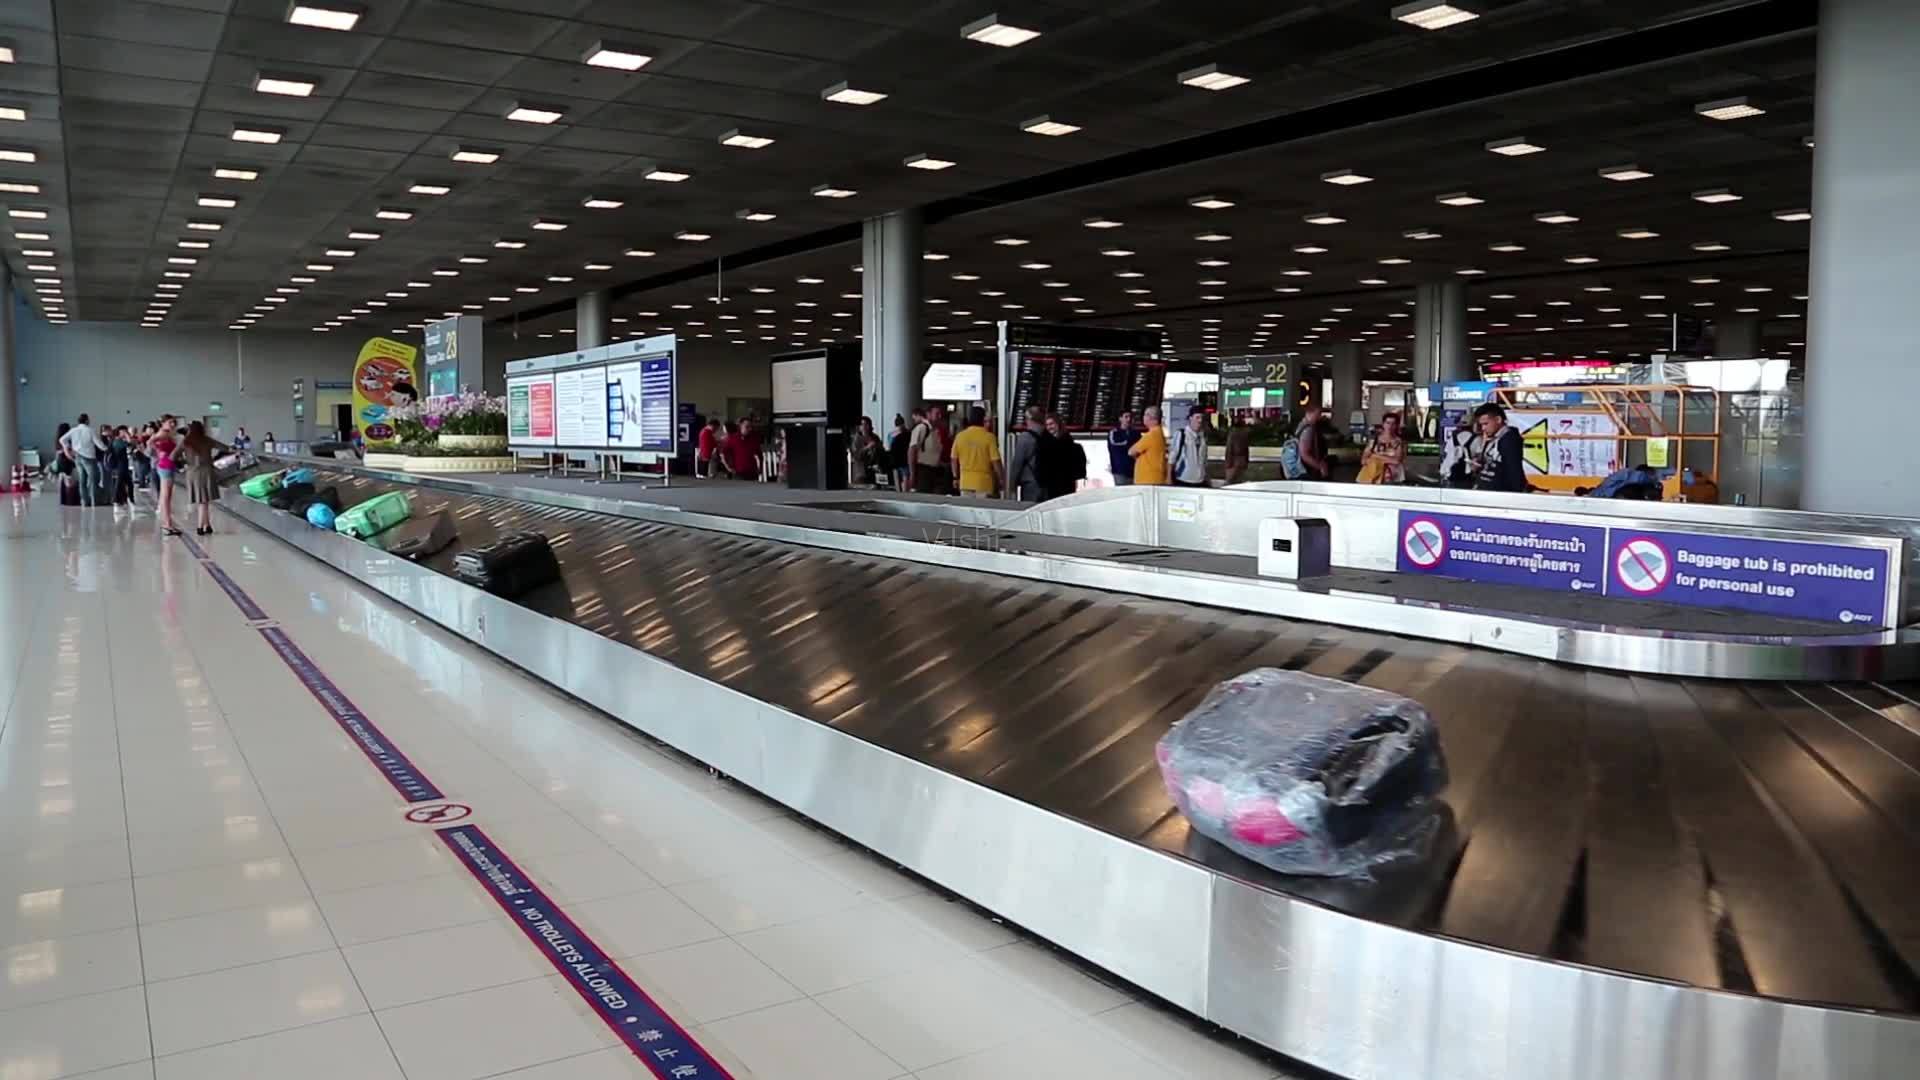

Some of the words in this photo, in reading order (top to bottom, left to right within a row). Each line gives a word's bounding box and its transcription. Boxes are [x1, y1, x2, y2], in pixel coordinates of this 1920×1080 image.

[446, 330, 458, 360] 23
[1266, 363, 1288, 383] 22
[1677, 549, 1741, 570] Baggage
[1743, 556, 1769, 571] tub
[1773, 558, 1786, 572] is
[1790, 562, 1875, 581] prohibited
[1676, 572, 1696, 587] for
[1699, 575, 1763, 594] personal
[1766, 584, 1796, 598] use
[521, 907, 543, 921] NO
[533, 914, 583, 963] TROLLEYS
[572, 962, 628, 1010] ALLOWED
